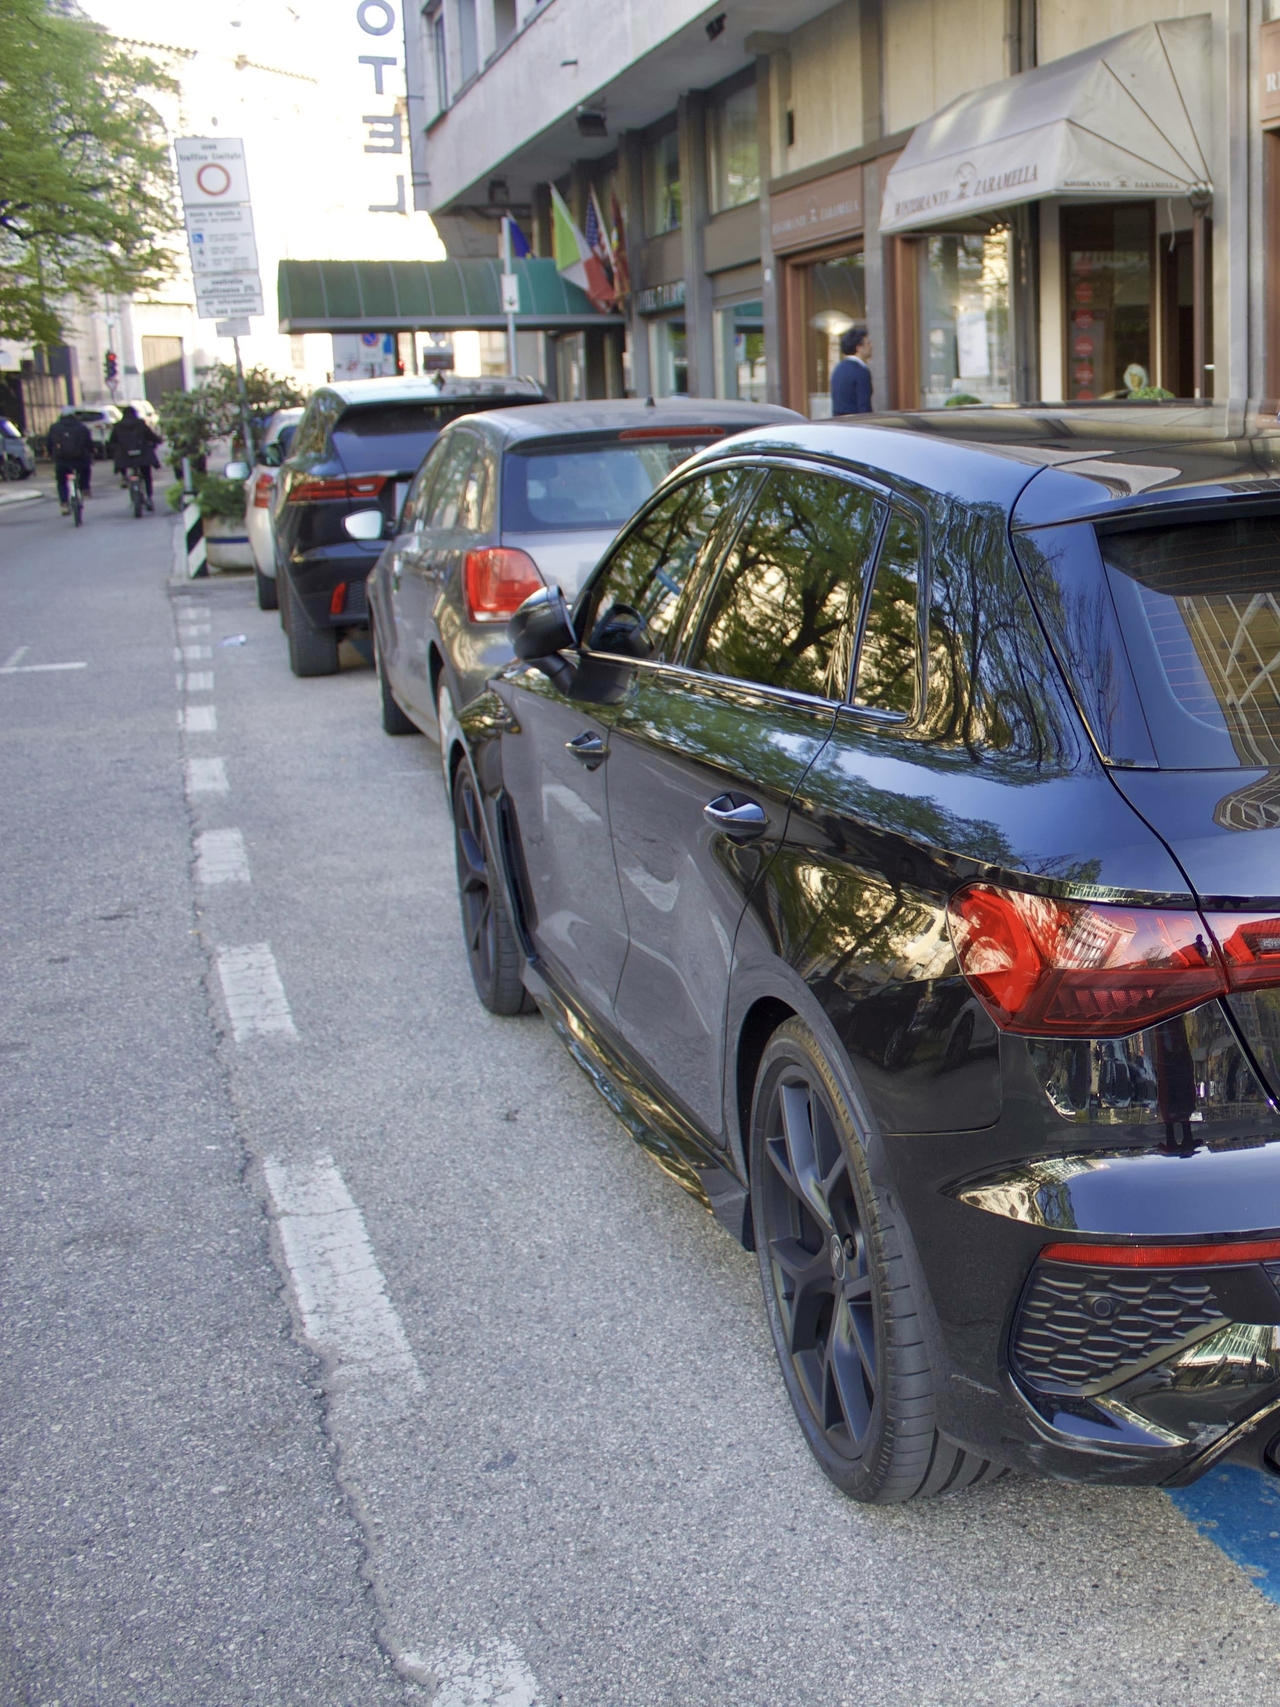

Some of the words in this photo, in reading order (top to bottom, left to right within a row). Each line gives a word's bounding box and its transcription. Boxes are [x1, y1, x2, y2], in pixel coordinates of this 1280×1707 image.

[894, 189, 951, 217] RISTORANTE
[973, 163, 1038, 197] ZARAMELLA
[1134, 181, 1180, 189] ZARAMELLA
